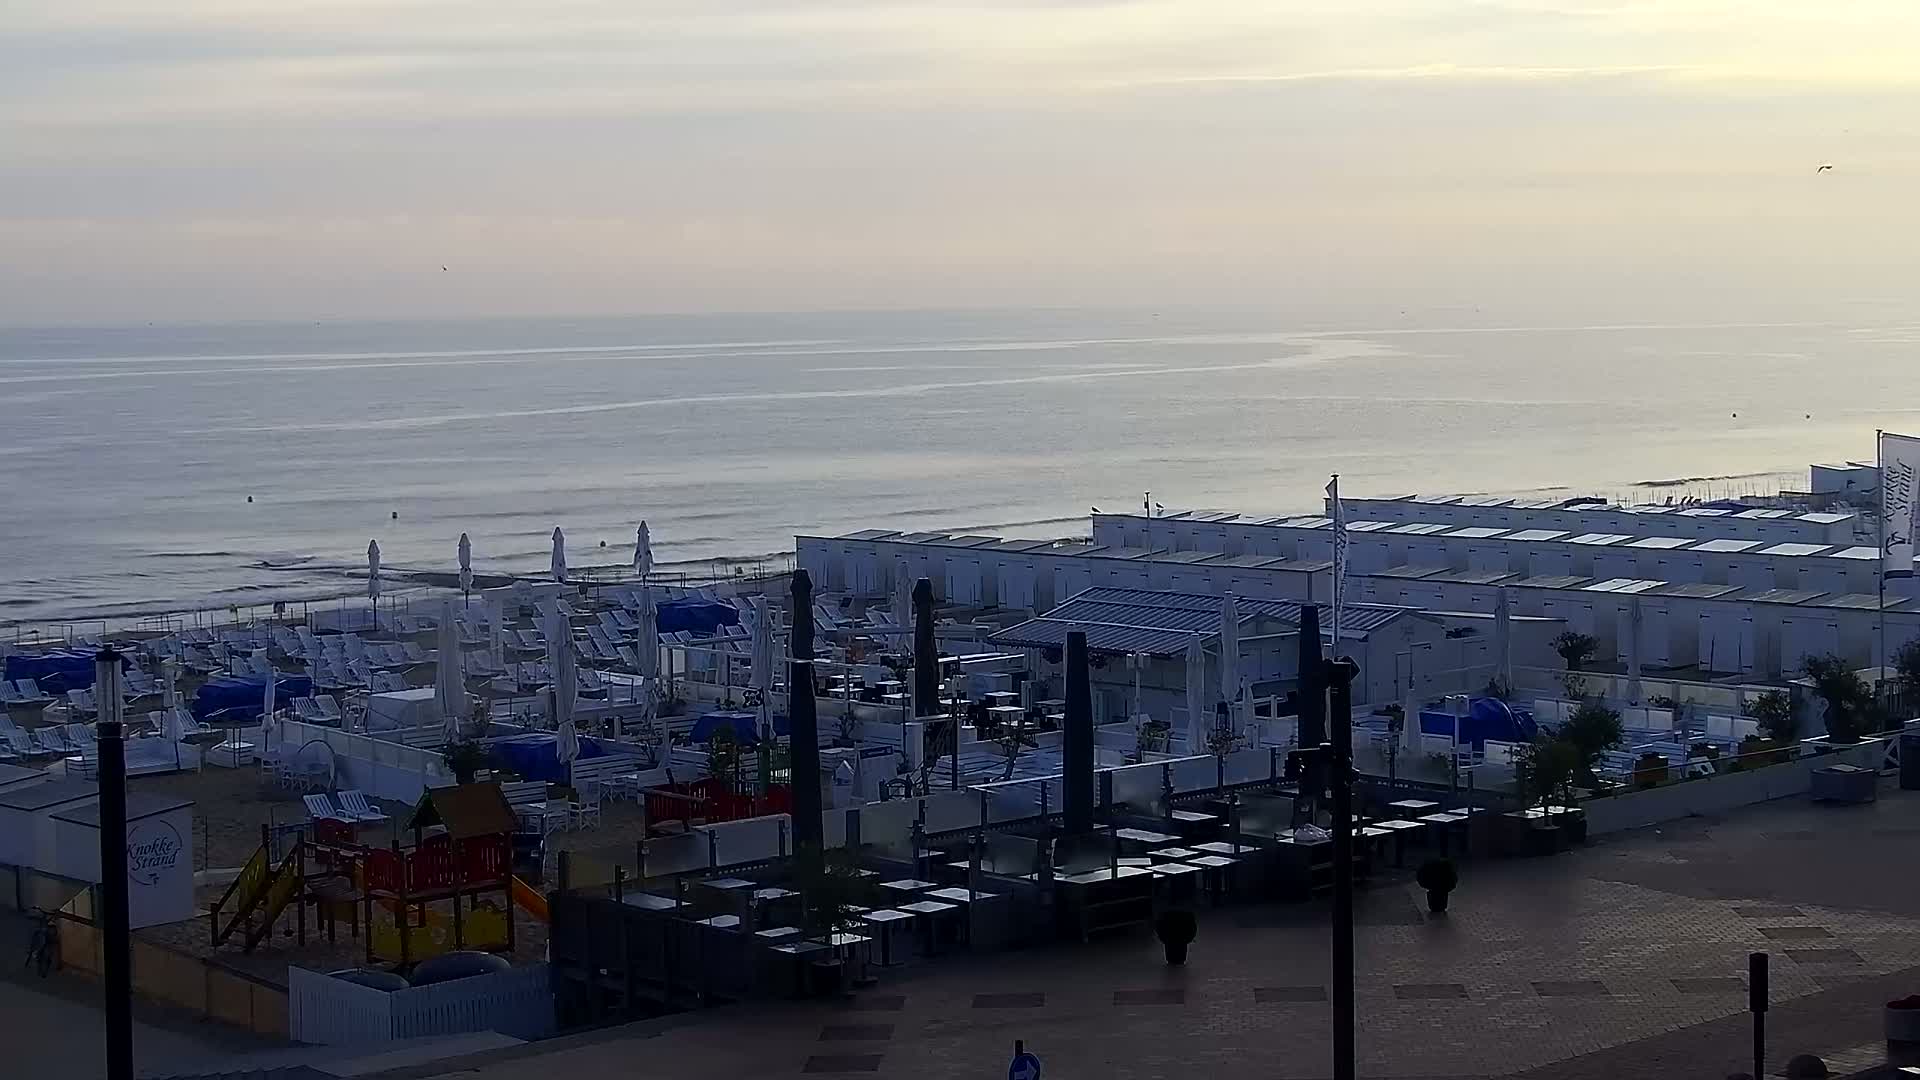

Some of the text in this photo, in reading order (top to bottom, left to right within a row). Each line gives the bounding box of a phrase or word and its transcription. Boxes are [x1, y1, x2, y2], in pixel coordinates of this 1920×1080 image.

[1883, 466, 1899, 522] Knokke
[1894, 458, 1912, 515] Strand
[127, 837, 173, 859] Knokke
[132, 848, 181, 871] Strand
